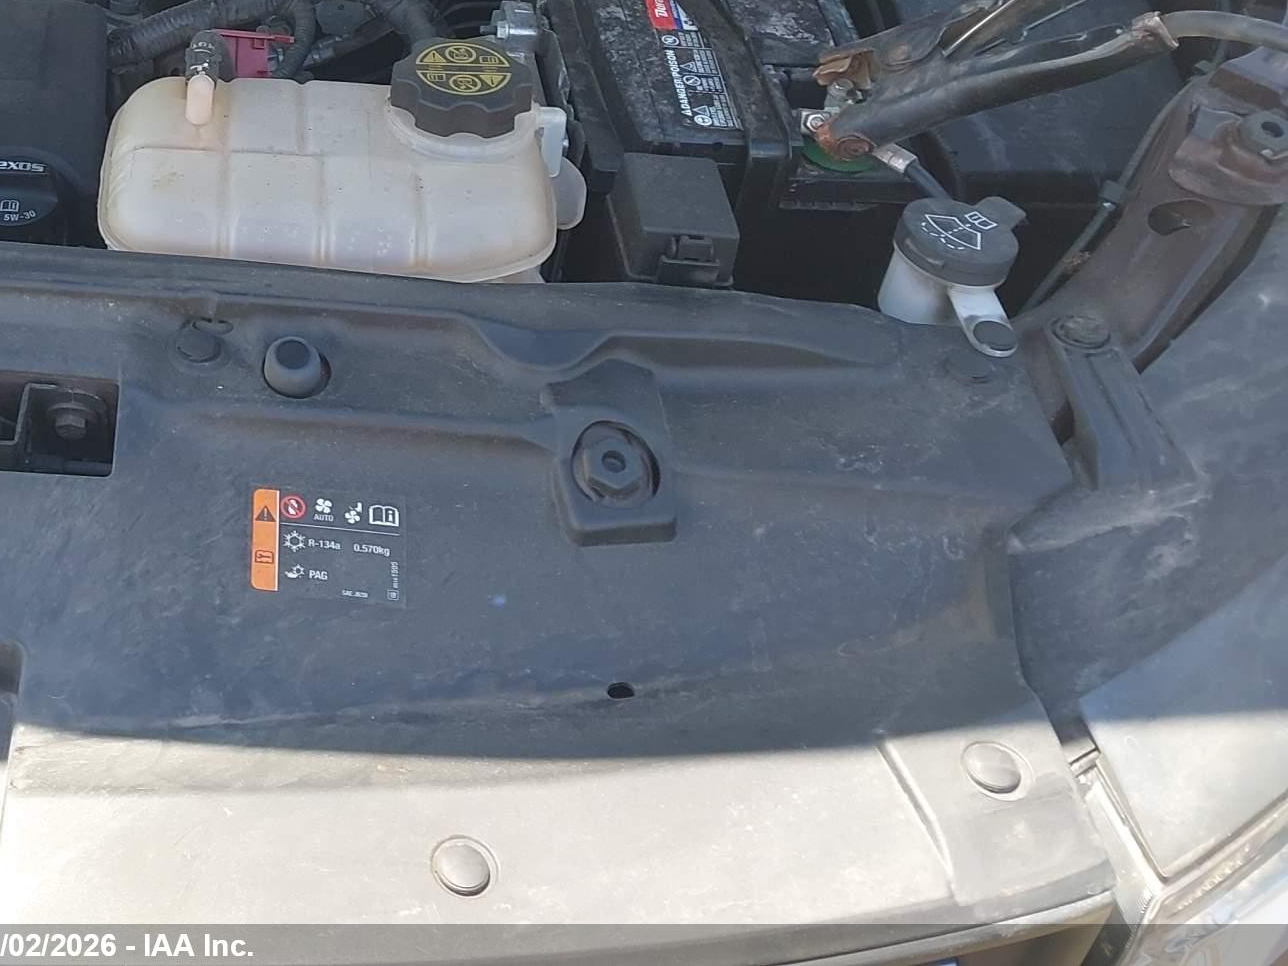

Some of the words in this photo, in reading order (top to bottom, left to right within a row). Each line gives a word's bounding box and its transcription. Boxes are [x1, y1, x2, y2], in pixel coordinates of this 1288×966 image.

[3, 210, 37, 222] 5W-30
[313, 514, 334, 523] AUTO
[308, 538, 341, 550] R-134a
[353, 543, 391, 557] 0.570kg
[309, 569, 328, 581] PAG
